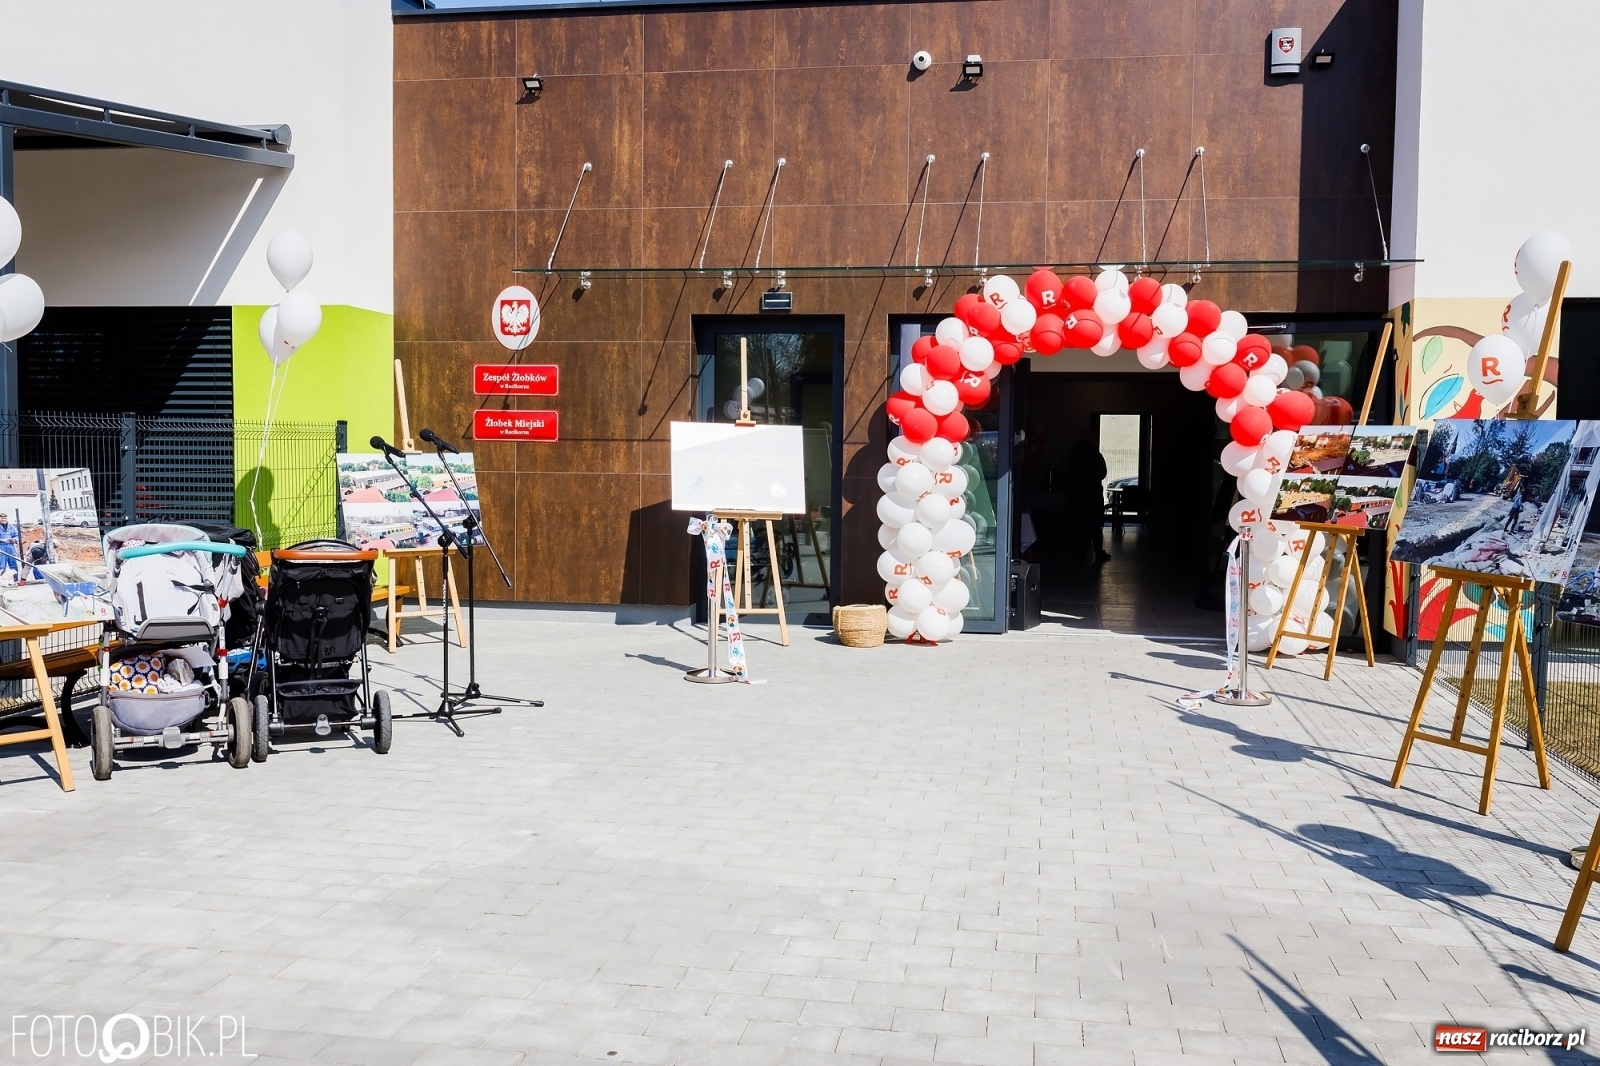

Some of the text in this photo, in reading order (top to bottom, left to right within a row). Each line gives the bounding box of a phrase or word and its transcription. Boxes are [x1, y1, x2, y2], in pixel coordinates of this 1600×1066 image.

[990, 292, 1004, 305] R
[1041, 290, 1056, 304] R
[1243, 352, 1258, 367] R
[1482, 356, 1501, 376] R
[483, 371, 547, 383] Zespół Żłobków
[966, 373, 982, 388] R
[485, 417, 544, 430] Żłobek Miejski
[1241, 510, 1256, 523] R
[1292, 539, 1305, 552] R
[710, 560, 720, 569] R
[894, 564, 907, 575] R
[889, 588, 898, 599] R
[733, 633, 741, 641] R
